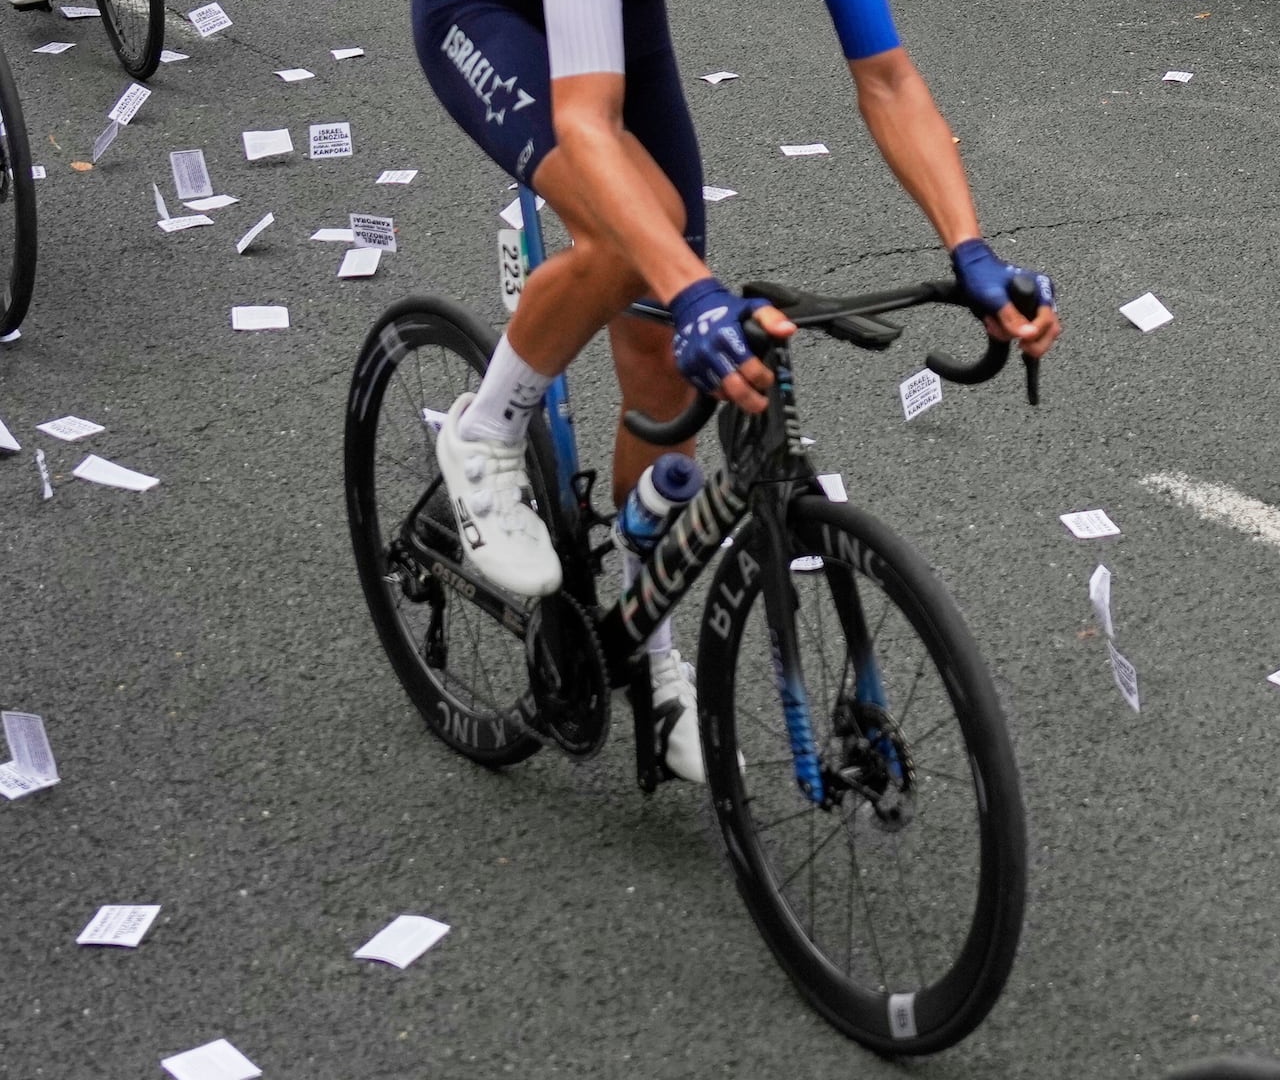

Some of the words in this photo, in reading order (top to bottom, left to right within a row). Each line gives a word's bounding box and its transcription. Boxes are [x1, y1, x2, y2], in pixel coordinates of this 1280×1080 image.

[440, 23, 495, 98] ISRAEL
[313, 134, 349, 142] GENOZIDA
[318, 127, 343, 136] ISRAEL
[502, 243, 522, 295] 223
